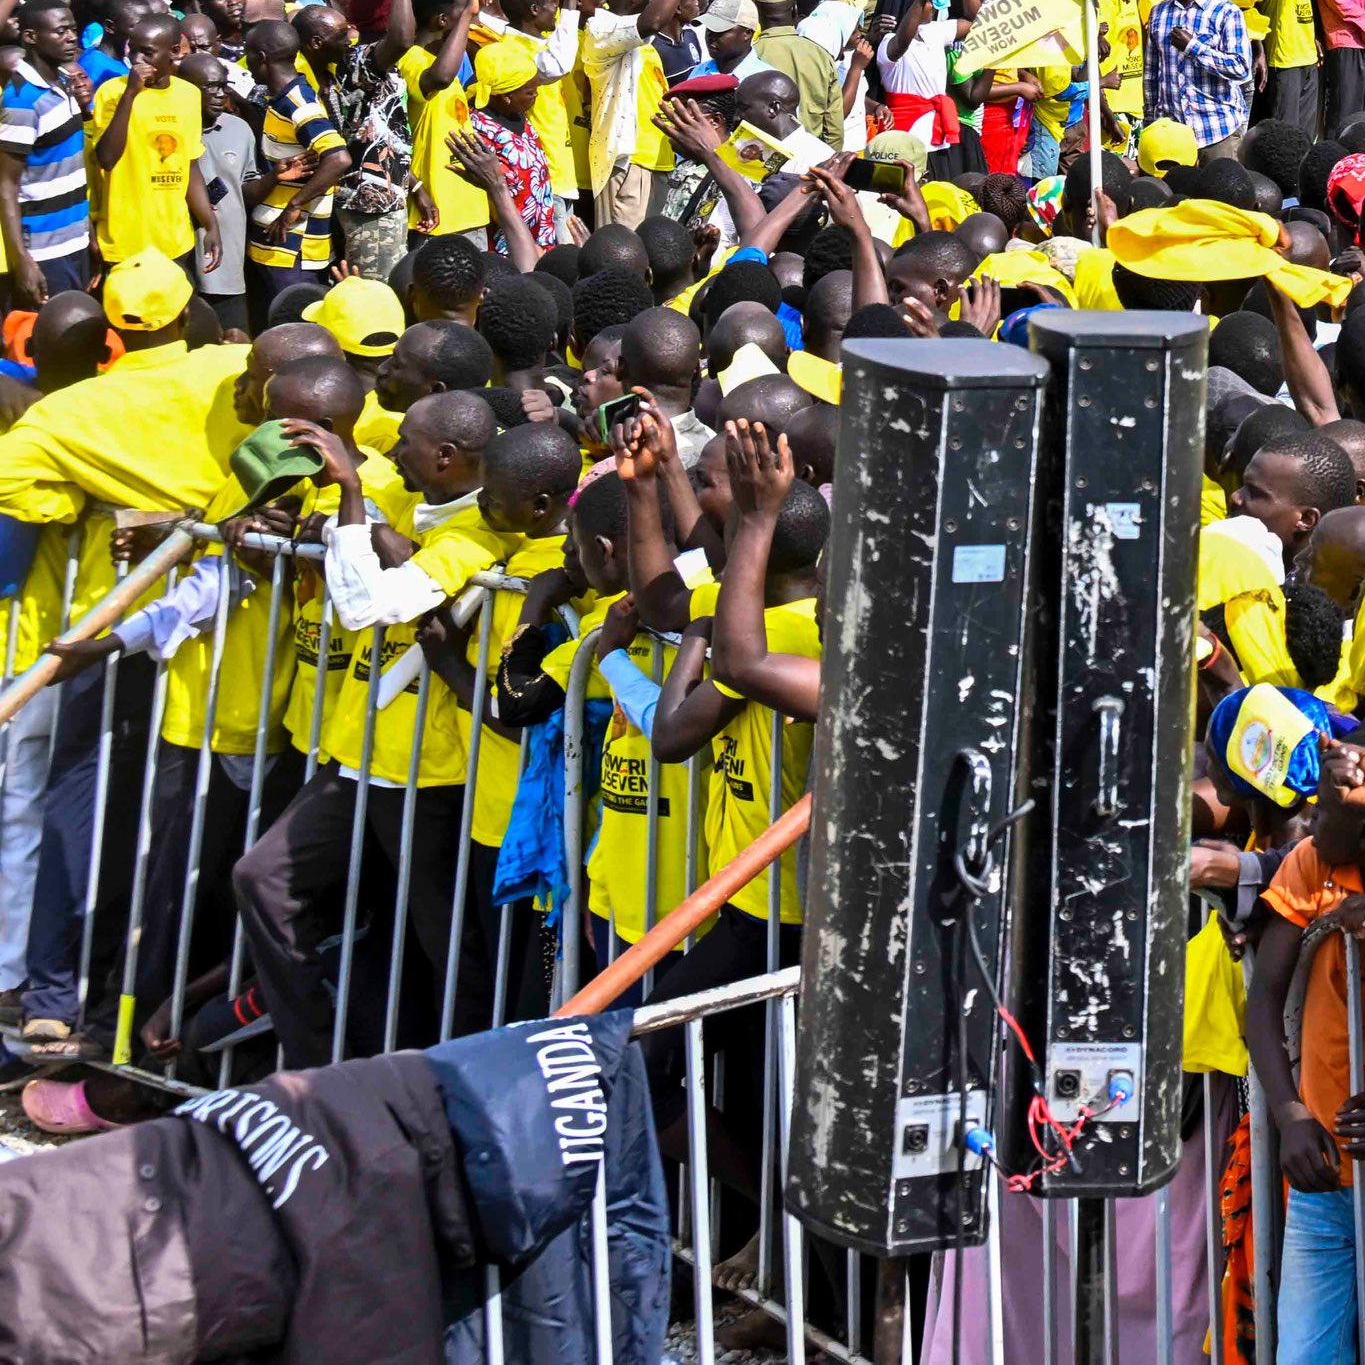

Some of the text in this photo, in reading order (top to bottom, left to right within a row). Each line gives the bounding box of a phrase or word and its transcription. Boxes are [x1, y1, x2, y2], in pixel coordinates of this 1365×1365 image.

[155, 115, 178, 124] VOTE
[870, 151, 899, 160] POLICE
[1076, 1045, 1128, 1054] DYNACORD
[526, 1021, 605, 1168] UGANDA
[174, 1089, 329, 1209] PRISONS
